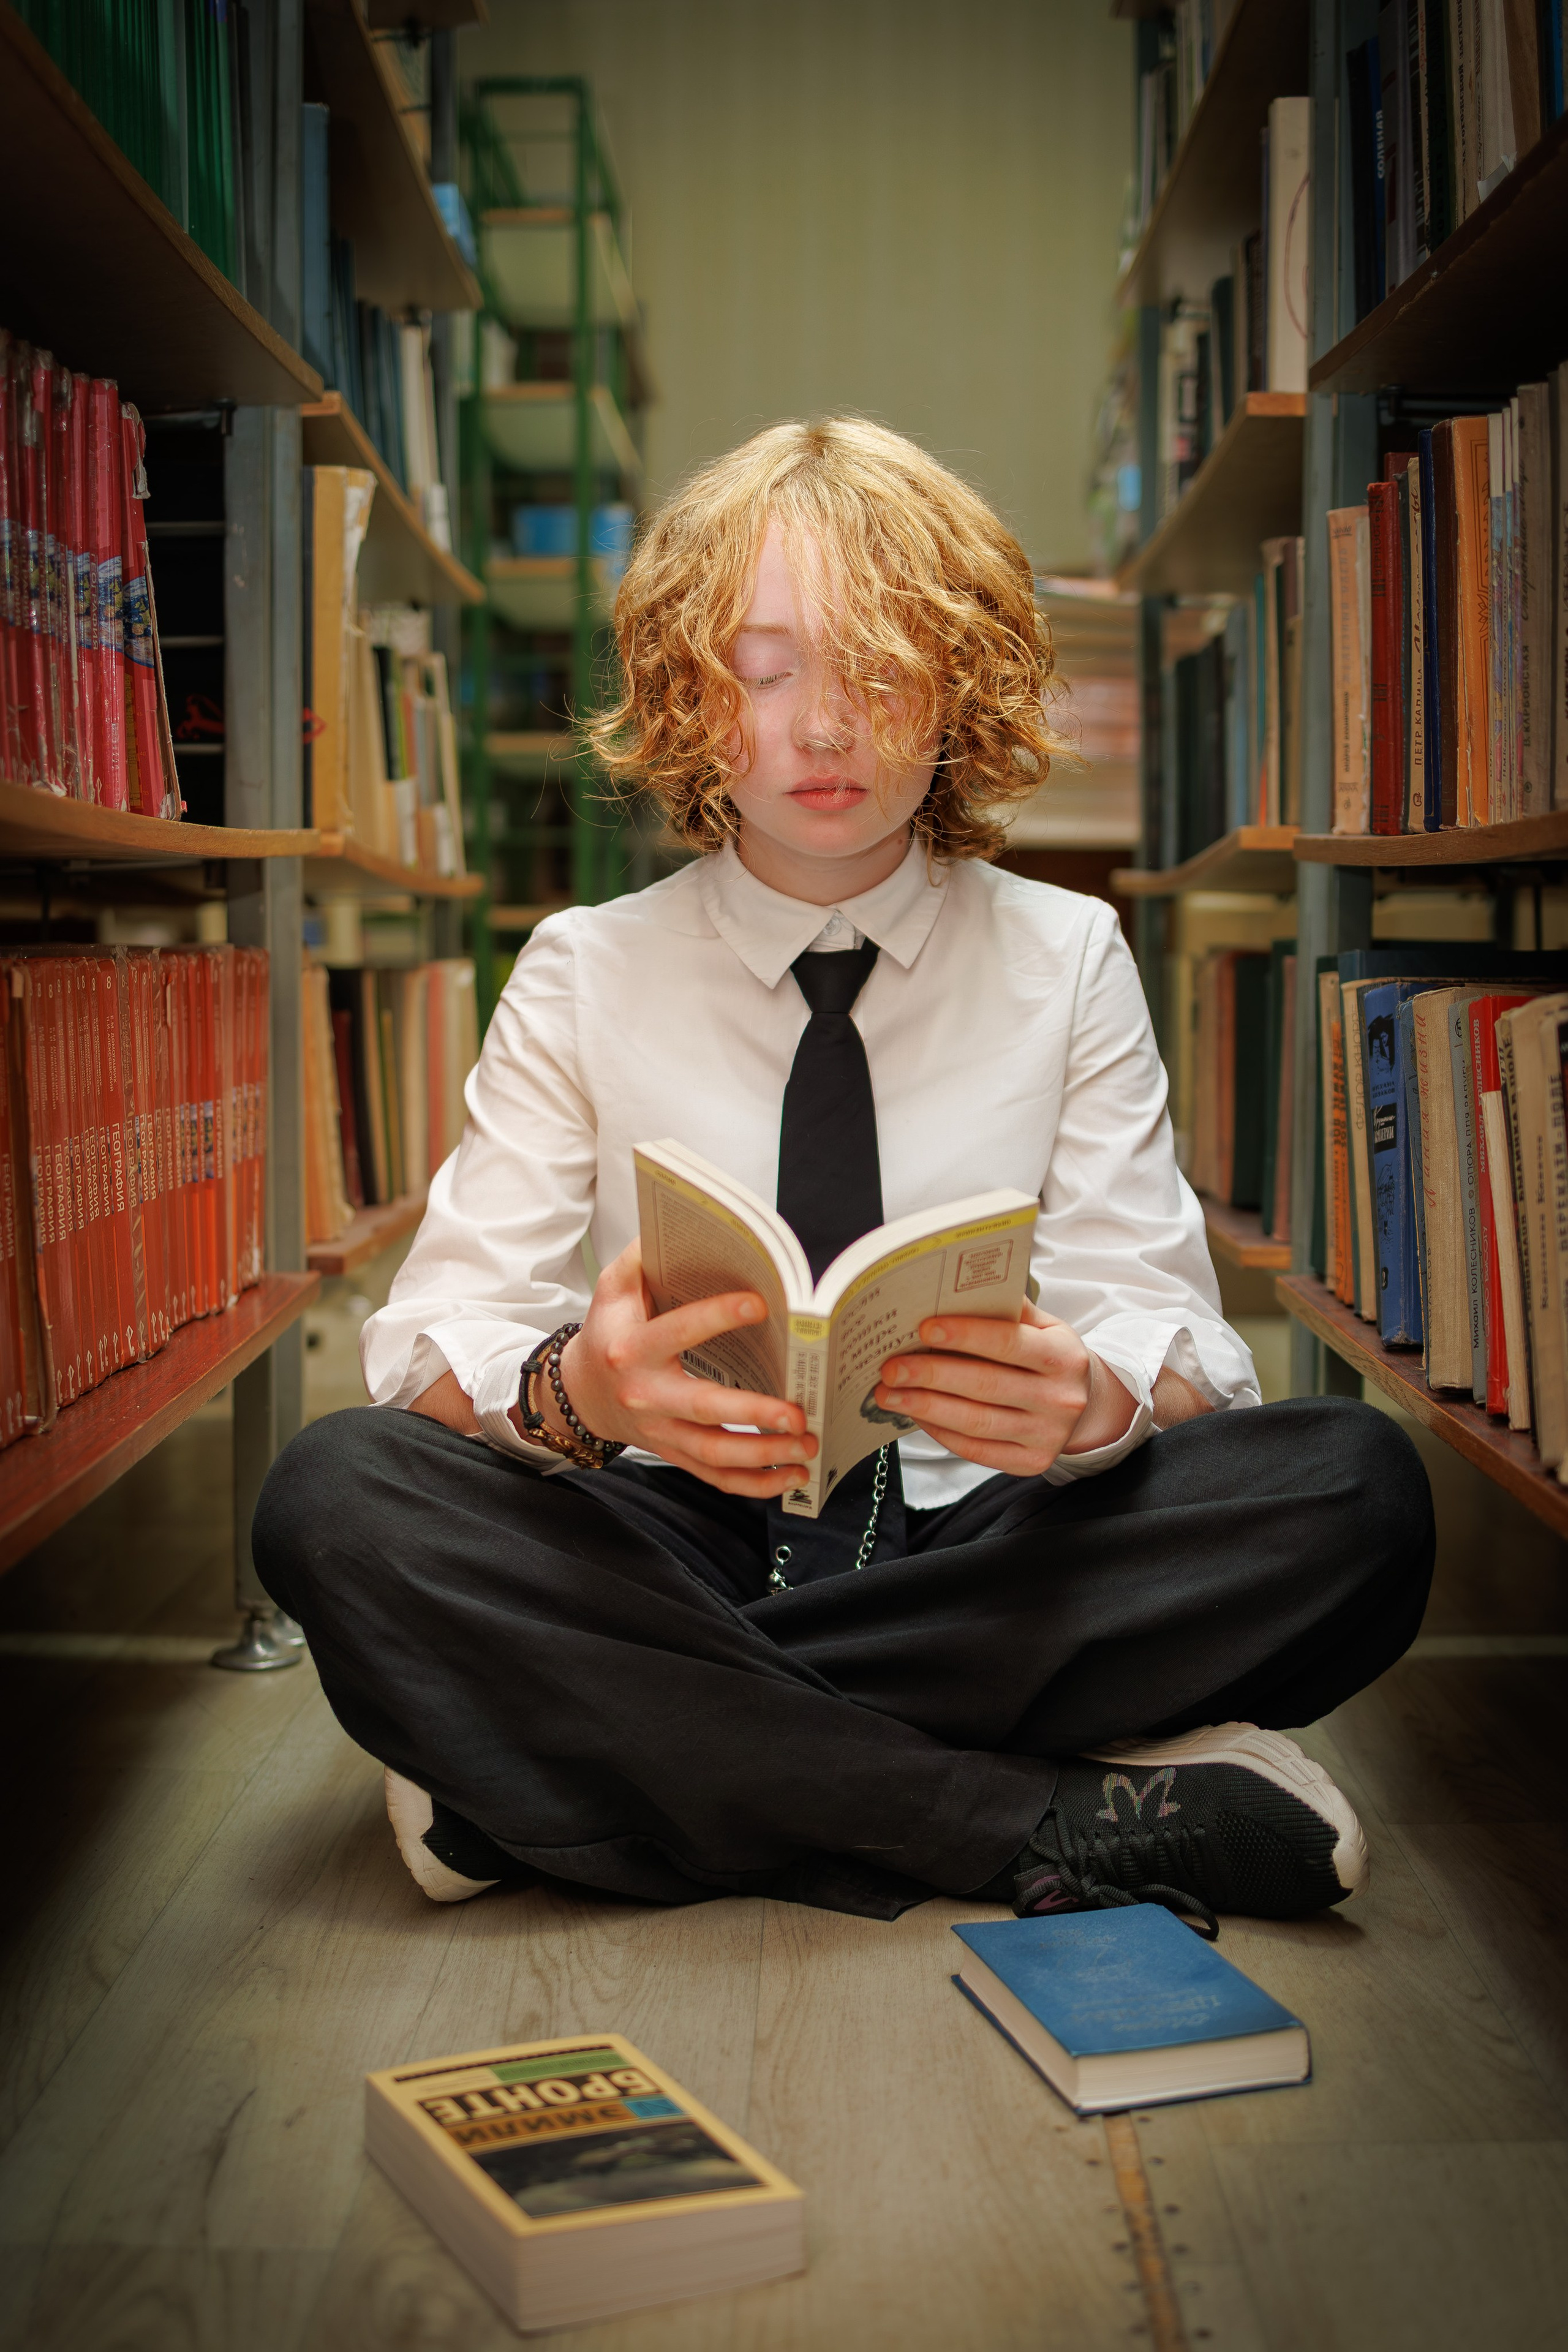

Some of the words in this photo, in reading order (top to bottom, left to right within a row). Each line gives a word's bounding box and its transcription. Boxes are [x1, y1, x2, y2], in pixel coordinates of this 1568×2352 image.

[1522, 645, 1531, 733] КАРБОВСКАЯ
[49, 984, 53, 998] 8
[56, 979, 61, 992] 8
[67, 980, 72, 993] 8
[81, 975, 86, 989] 8
[91, 978, 96, 991] 8
[107, 976, 111, 989] 8
[1351, 1003, 1362, 1067] КНОРРЕ
[1415, 1014, 1429, 1100] жизни
[1473, 1019, 1483, 1107] КОЛЕСНИКОВ
[36, 1145, 47, 1244] ГЕОГРАФИЯ
[45, 1145, 55, 1243] ГЕОГРАФИЯ
[55, 1144, 66, 1240] ГЕОГРАФИЯ
[64, 1137, 73, 1231] ГЕОГРАФИЯ
[74, 1136, 84, 1229] ГЕОГРАФИЯ
[85, 1129, 95, 1221] ГЕОГРАФИЯ
[89, 1126, 99, 1218] ГЕОГРАФИЯ
[99, 1126, 110, 1217] ГЕОГРАФИЯ
[113, 1123, 125, 1212] ГЕОГРАФИЯ
[127, 1120, 137, 1208] ГЕОГРАФИЯ
[140, 1115, 149, 1201] ГЕОГРАФИЯ
[148, 1114, 156, 1200] ГЕОГРАФИЯ
[1422, 1112, 1436, 1208] Линия
[1468, 1207, 1477, 1294] КОЛЕСНИКОВ
[851, 1324, 898, 1362] мире
[423, 2068, 658, 2127] БРОНТЕ
[458, 2106, 620, 2145] ЭМИЛИ
